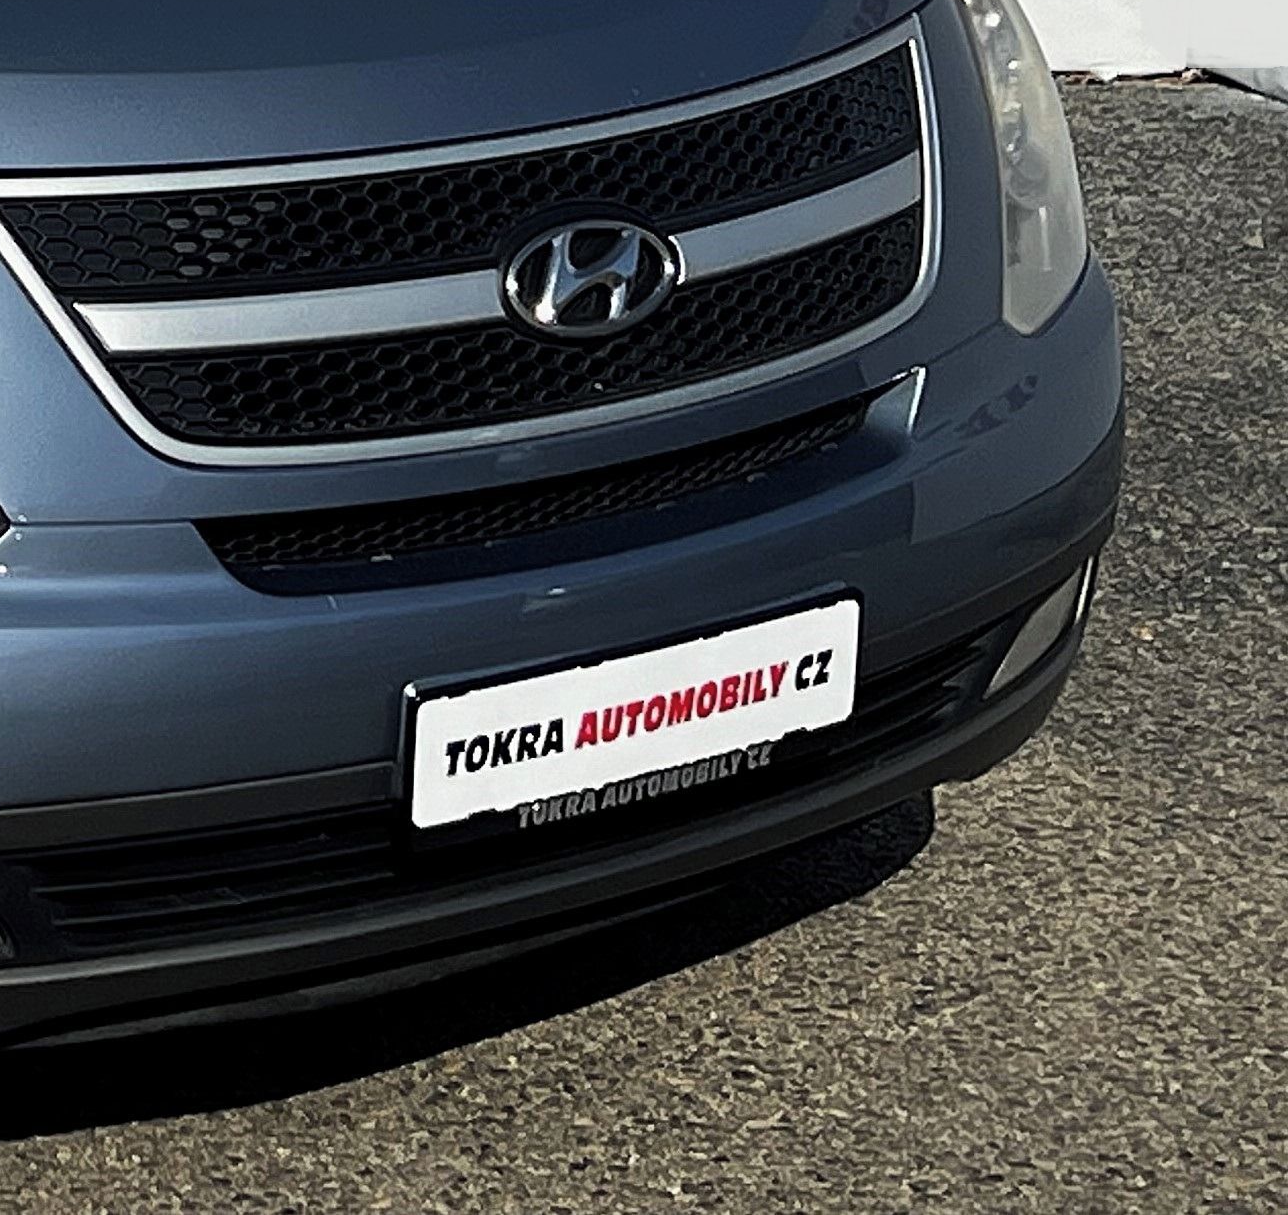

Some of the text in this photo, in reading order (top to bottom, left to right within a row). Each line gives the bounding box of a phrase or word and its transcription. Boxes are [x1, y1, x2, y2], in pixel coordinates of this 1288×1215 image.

[445, 649, 834, 777] TOKRA AUTOMOBILY CZ
[518, 791, 596, 828] TOKRA
[601, 749, 744, 810] AUTOMOBILY
